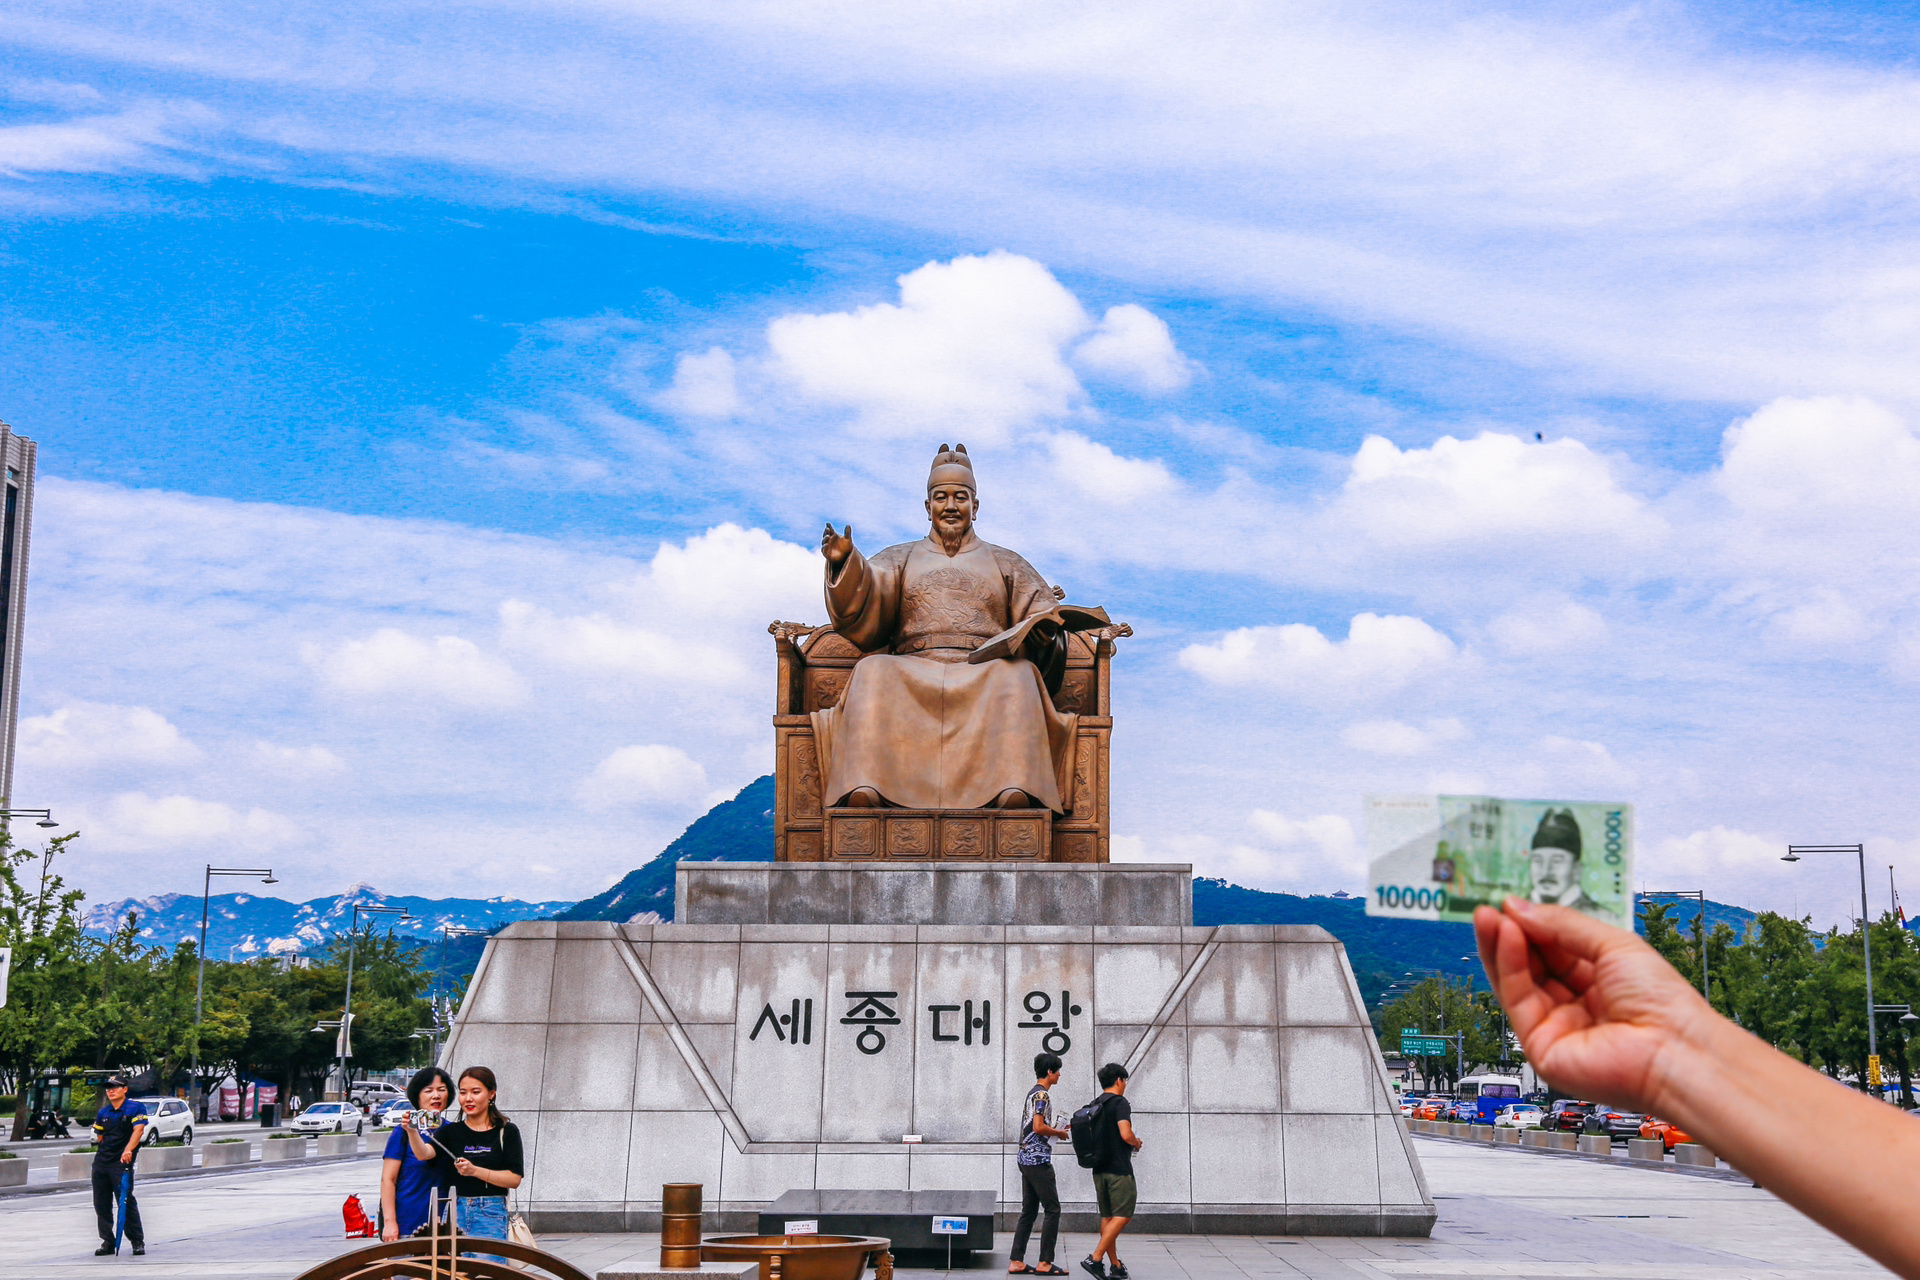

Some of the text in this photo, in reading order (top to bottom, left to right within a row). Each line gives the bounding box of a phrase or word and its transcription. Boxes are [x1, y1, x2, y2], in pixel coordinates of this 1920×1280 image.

[1604, 811, 1622, 866] 10000
[1375, 885, 1447, 911] 10000
[749, 990, 1082, 1056] 세종대왕
